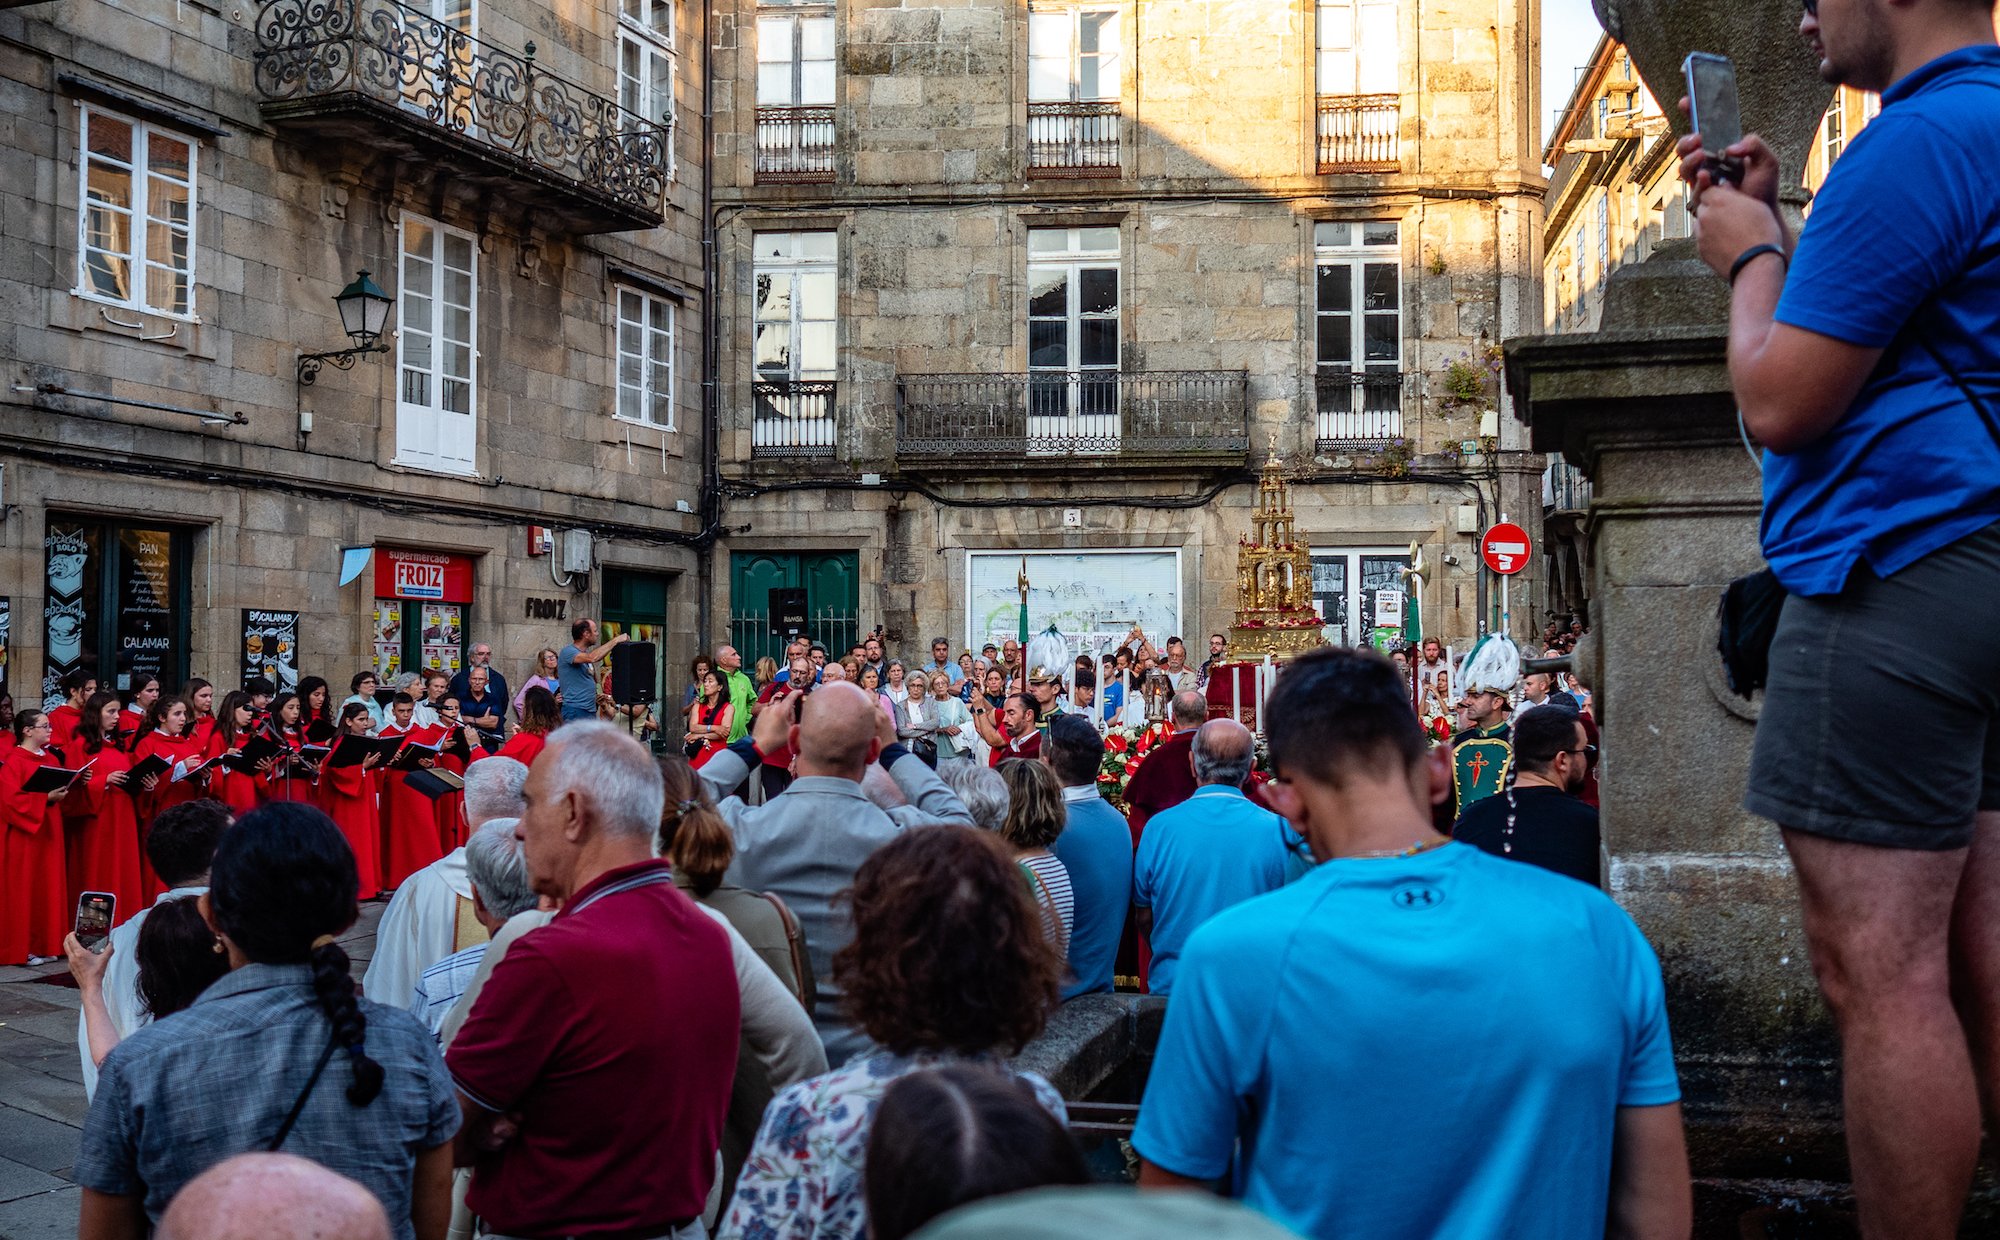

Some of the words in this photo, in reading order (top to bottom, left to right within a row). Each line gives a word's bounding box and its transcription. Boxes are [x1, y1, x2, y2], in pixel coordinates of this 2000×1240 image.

[45, 536, 88, 551] BOCALAMAR
[56, 544, 77, 553] ROLO
[139, 543, 159, 554] PAN
[389, 551, 450, 564] supermercado
[398, 564, 441, 587] FROIZ
[44, 605, 87, 620] BOCALAMAR
[525, 597, 567, 620] FROIZ
[249, 611, 293, 622] BOCALAMAR
[783, 615, 804, 623] RAMSA
[123, 636, 170, 649] CALAMAR
